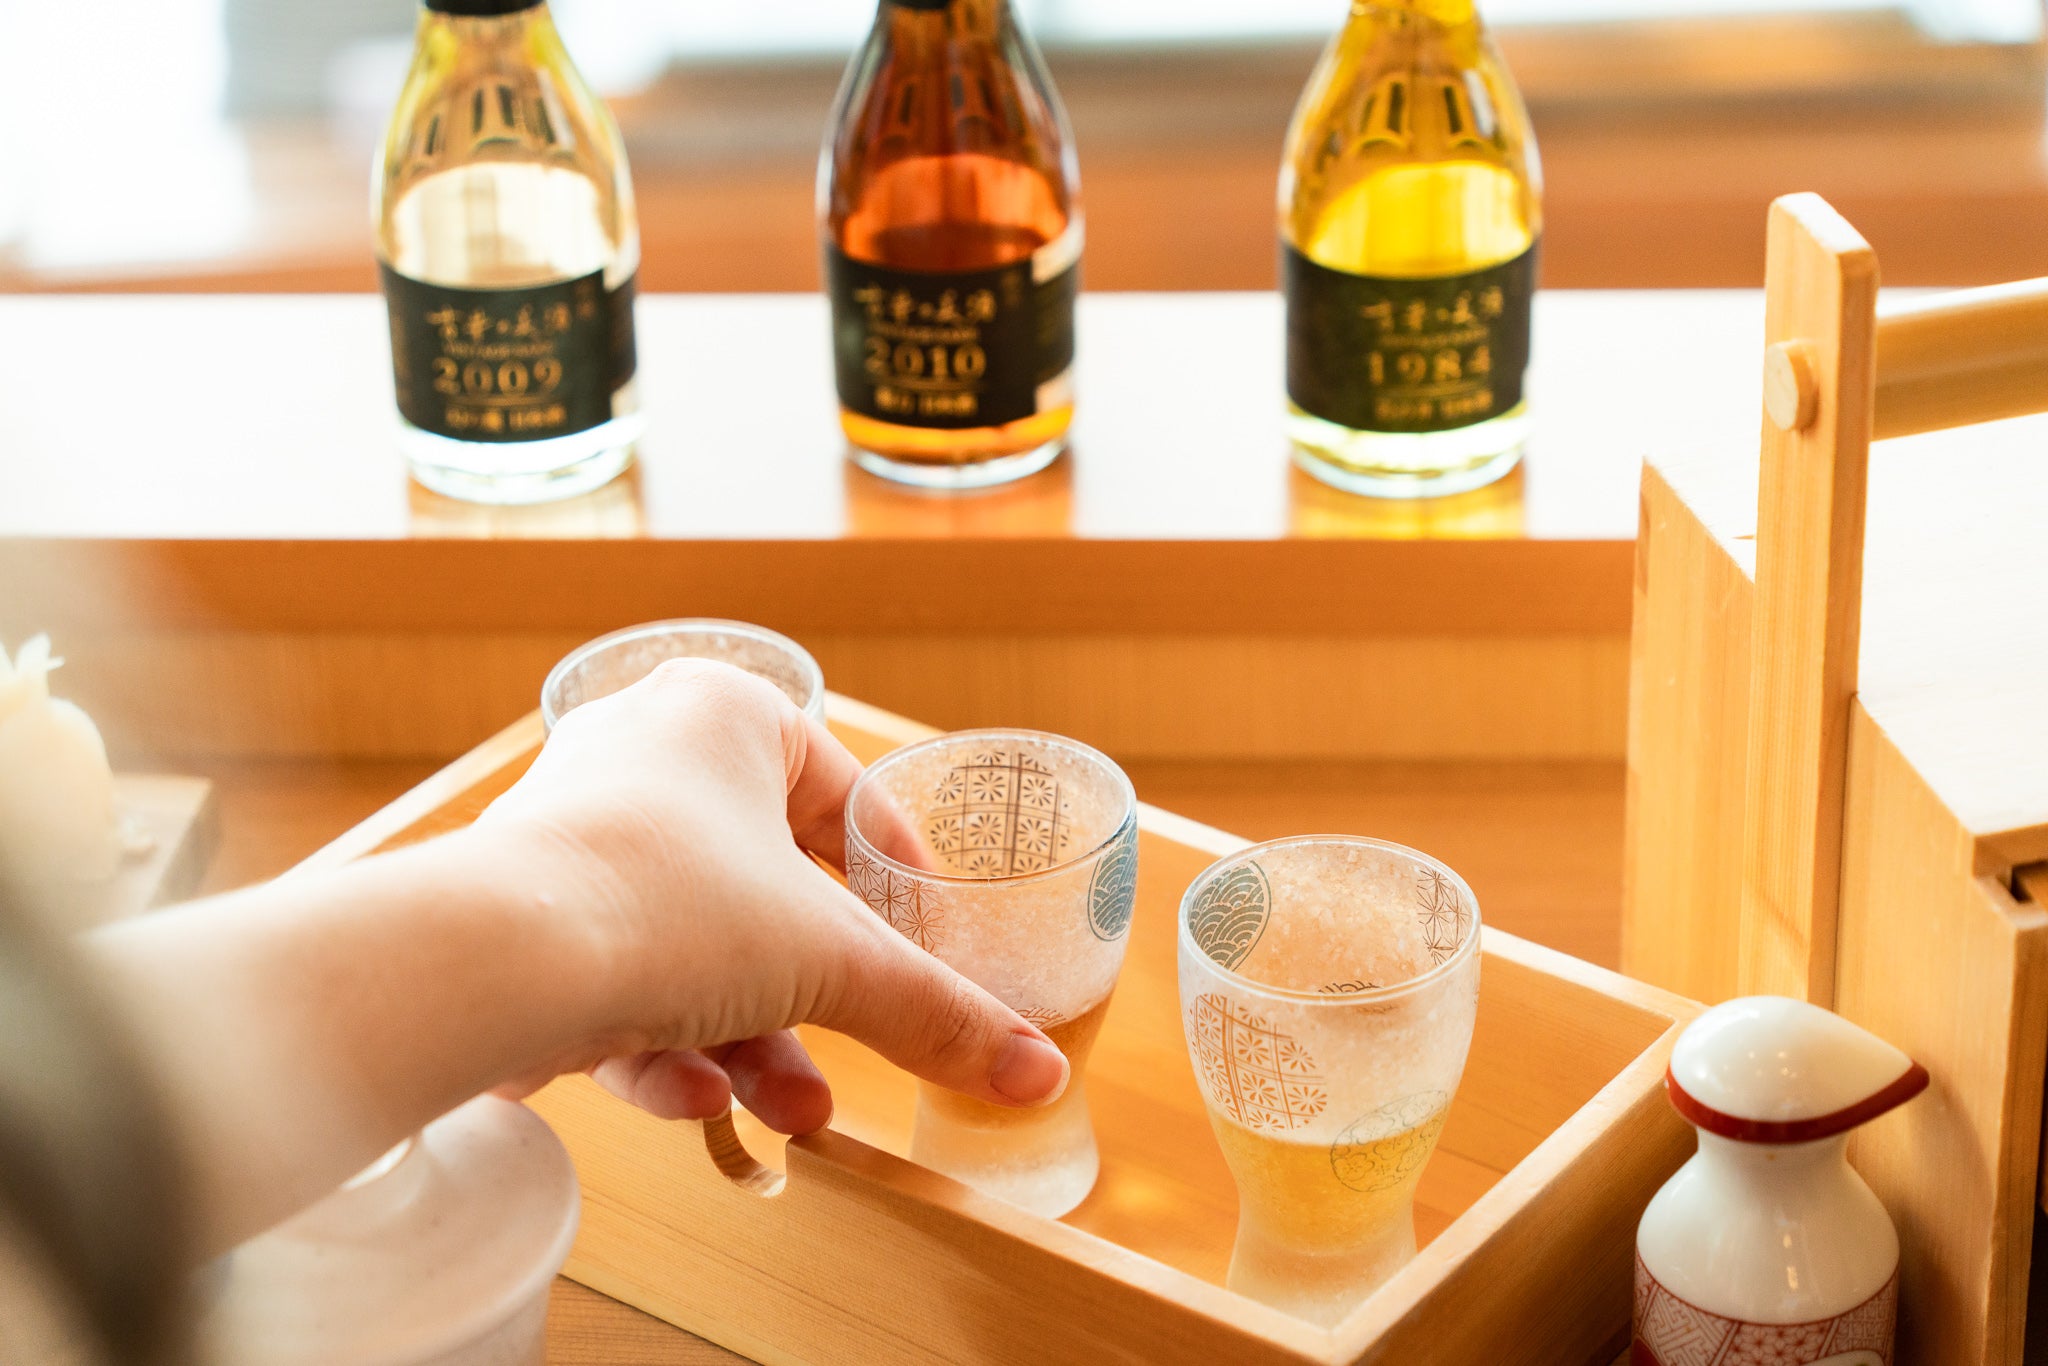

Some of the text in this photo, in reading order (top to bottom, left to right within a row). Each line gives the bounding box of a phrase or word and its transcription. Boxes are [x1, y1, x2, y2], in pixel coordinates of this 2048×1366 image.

[432, 357, 562, 395] 2009
[865, 337, 986, 380] 2010
[1369, 347, 1490, 385] 1984
